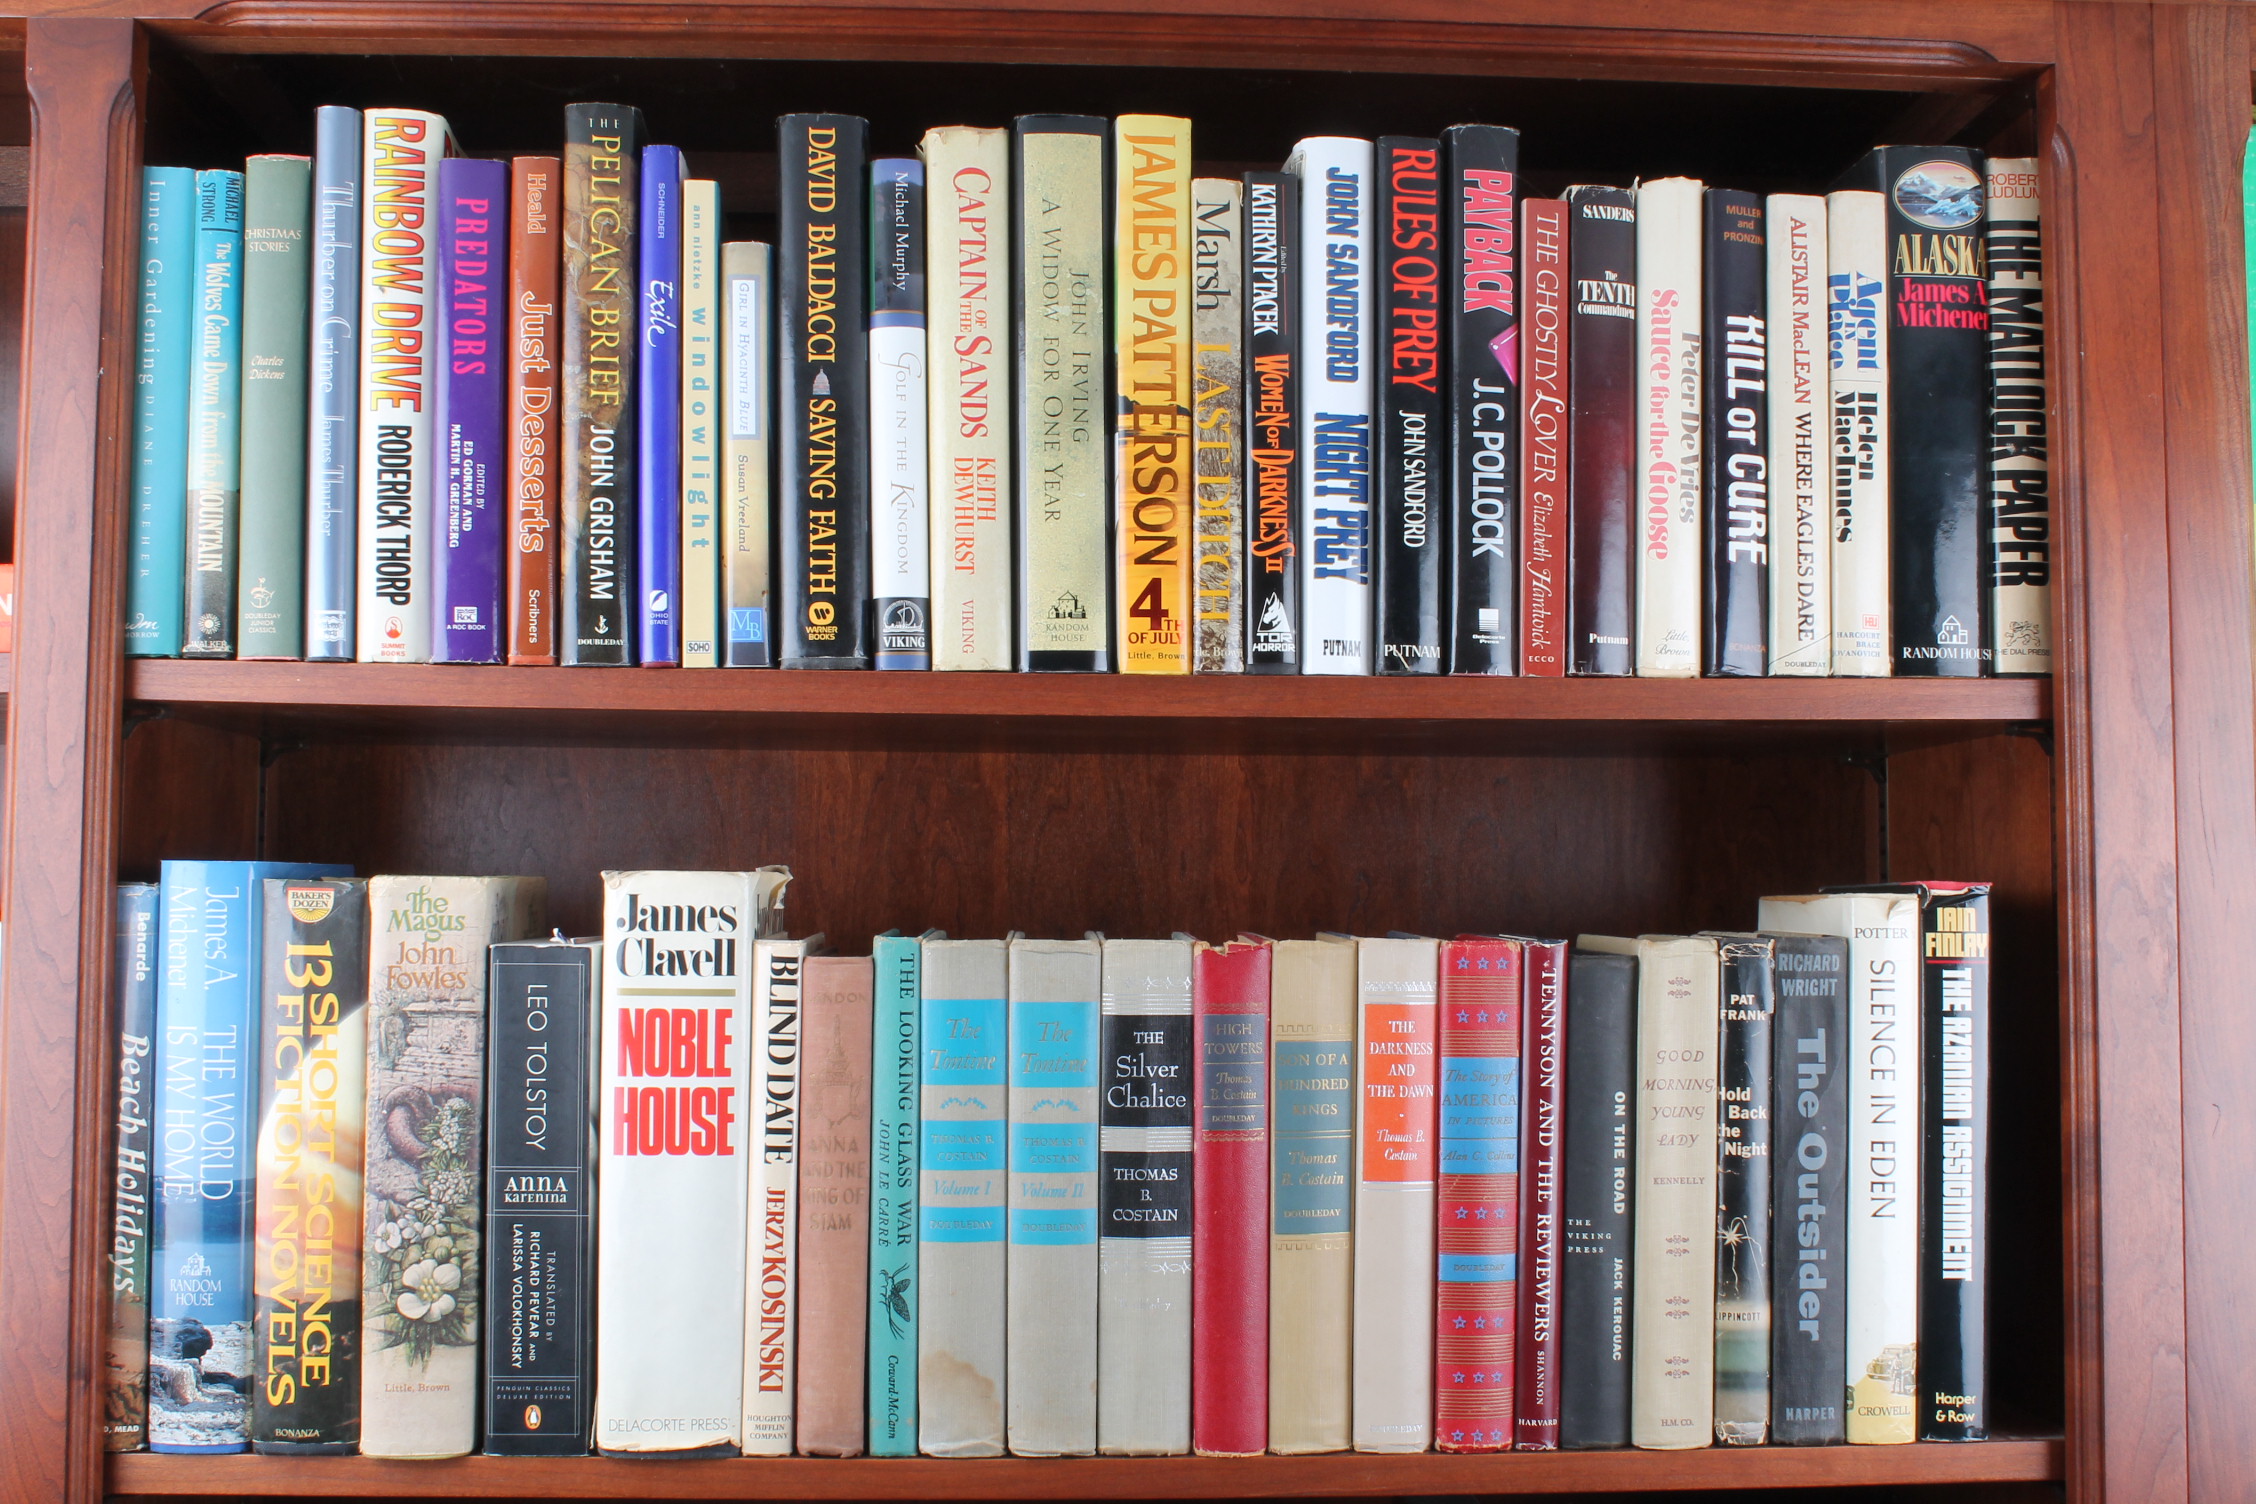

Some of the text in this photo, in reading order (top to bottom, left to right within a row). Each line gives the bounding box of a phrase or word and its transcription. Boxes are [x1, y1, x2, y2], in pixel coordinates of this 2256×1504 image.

[589, 118, 619, 128] THE
[528, 173, 546, 234] Heald
[1582, 204, 1634, 223] SANDERS
[1726, 205, 1762, 218] MULLER
[244, 229, 301, 240] CHRISTMAS
[249, 242, 290, 252] STORIES
[808, 127, 836, 363] DAVID BALDACCI
[892, 172, 909, 291] Michael Murphy
[952, 167, 991, 328] CAPTAIN OF
[1196, 199, 1231, 311] Marsh
[1464, 169, 1513, 316] PAYBACK
[138, 180, 166, 384] Inner Gardening
[371, 117, 426, 412] RAINBOW DRIVE
[452, 198, 489, 374] PREDATORS
[589, 135, 621, 405] PELICAN BRIEF
[1326, 167, 1359, 383] JOHN SANDFORD
[1392, 148, 1438, 393] RULES OF PREY
[648, 280, 677, 348] Exile
[959, 303, 971, 332] THE
[1069, 269, 1090, 443] JOHN IRVING
[1124, 133, 1179, 566] JAMES PATTERSON
[1529, 212, 1565, 482] THE GHOSTLY LOVER
[198, 242, 231, 571] The Wolves Came Down from the MOUNTAIN
[954, 335, 994, 438] SANDS
[519, 291, 552, 552] Just Desserts
[462, 441, 473, 532] ED GORMAN AND
[808, 399, 836, 595] SAVING FAITH
[977, 458, 996, 521] KEITH
[1314, 412, 1368, 585] NIGHT PREY
[1399, 410, 1426, 548] JOHN SANDFORD
[376, 425, 412, 606] RODERICK THORP
[589, 425, 616, 600] JOHN GRISHAM
[954, 457, 974, 574] DEWHURST
[1795, 412, 1815, 641] WHERE EAGLES DARE
[529, 589, 540, 643] Scribners
[806, 626, 838, 634] WARNER
[962, 600, 974, 654] VIKING
[1257, 632, 1292, 642] TOR
[1589, 633, 1628, 645] Putnam
[883, 636, 925, 648] VIKING
[1252, 642, 1295, 651] HORROR
[1323, 639, 1361, 657] PUTNAM
[1385, 644, 1440, 658] PUTNAM
[387, 910, 465, 941] Magus
[617, 894, 737, 932] James
[1855, 928, 1908, 939] POTTER
[284, 941, 334, 988] 13
[387, 966, 466, 990] Fowles
[617, 938, 737, 977] Clavell
[1778, 954, 1840, 972] RICHARD
[768, 954, 799, 1065] BLIND
[1731, 994, 1754, 1005] PAT
[1782, 978, 1838, 997] WRIGHT
[946, 1018, 981, 1039] The
[1134, 1032, 1164, 1044] THE
[1216, 1024, 1252, 1036] HIGH
[1388, 1021, 1416, 1033] THE
[1720, 1009, 1766, 1020] FRANK
[618, 1008, 732, 1077] NOBLE
[930, 1050, 998, 1071] Tontine
[1116, 1053, 1178, 1078] Silver
[1369, 1042, 1432, 1055] DARKNESS
[526, 984, 548, 1150] LEO TOLSTOY
[1388, 1064, 1415, 1076] AND
[1869, 961, 1896, 1218] SILENCE IN EDEN
[897, 953, 915, 1246] THE LOOKING GLASS WAR
[1107, 1085, 1186, 1108] Chalice
[1368, 1085, 1434, 1098] THE DAWN
[1729, 1105, 1766, 1119] Back
[613, 1088, 734, 1155] HOUSE
[765, 1072, 794, 1163] DATE
[1534, 967, 1557, 1342] TENNYSON AND THE REVIEWERS
[1613, 1091, 1626, 1214] ON THE ROAD
[1725, 1142, 1767, 1158] Night
[1114, 1168, 1178, 1180] THOMAS
[1141, 1189, 1152, 1201] B.
[1798, 1028, 1827, 1341] The Outsider
[1112, 1208, 1178, 1221] COSTAIN
[530, 1231, 540, 1286] RICHARD
[170, 1280, 221, 1291] RANDOM
[176, 1293, 214, 1306] HOUSE
[512, 1224, 523, 1369] LARISSA VOLOKHONSKY
[547, 1251, 556, 1341] TRANSLATED BY
[758, 1187, 786, 1393] JERZY KOSINSKI
[1613, 1258, 1623, 1360] JACK KEROUAC
[529, 1290, 539, 1338] PEVEAR
[385, 1384, 449, 1392] Little, Brown
[1536, 1351, 1545, 1405] SHANNON
[1936, 1392, 1976, 1405] Harper
[275, 1429, 319, 1437] BONANZA
[609, 1418, 728, 1431] DELACORTE PRESS
[1518, 1418, 1558, 1426] HARVARD
[1786, 1407, 1835, 1420] HARPER
[1858, 1406, 1911, 1417] CROWELL
[1936, 1411, 1975, 1422] & Row
